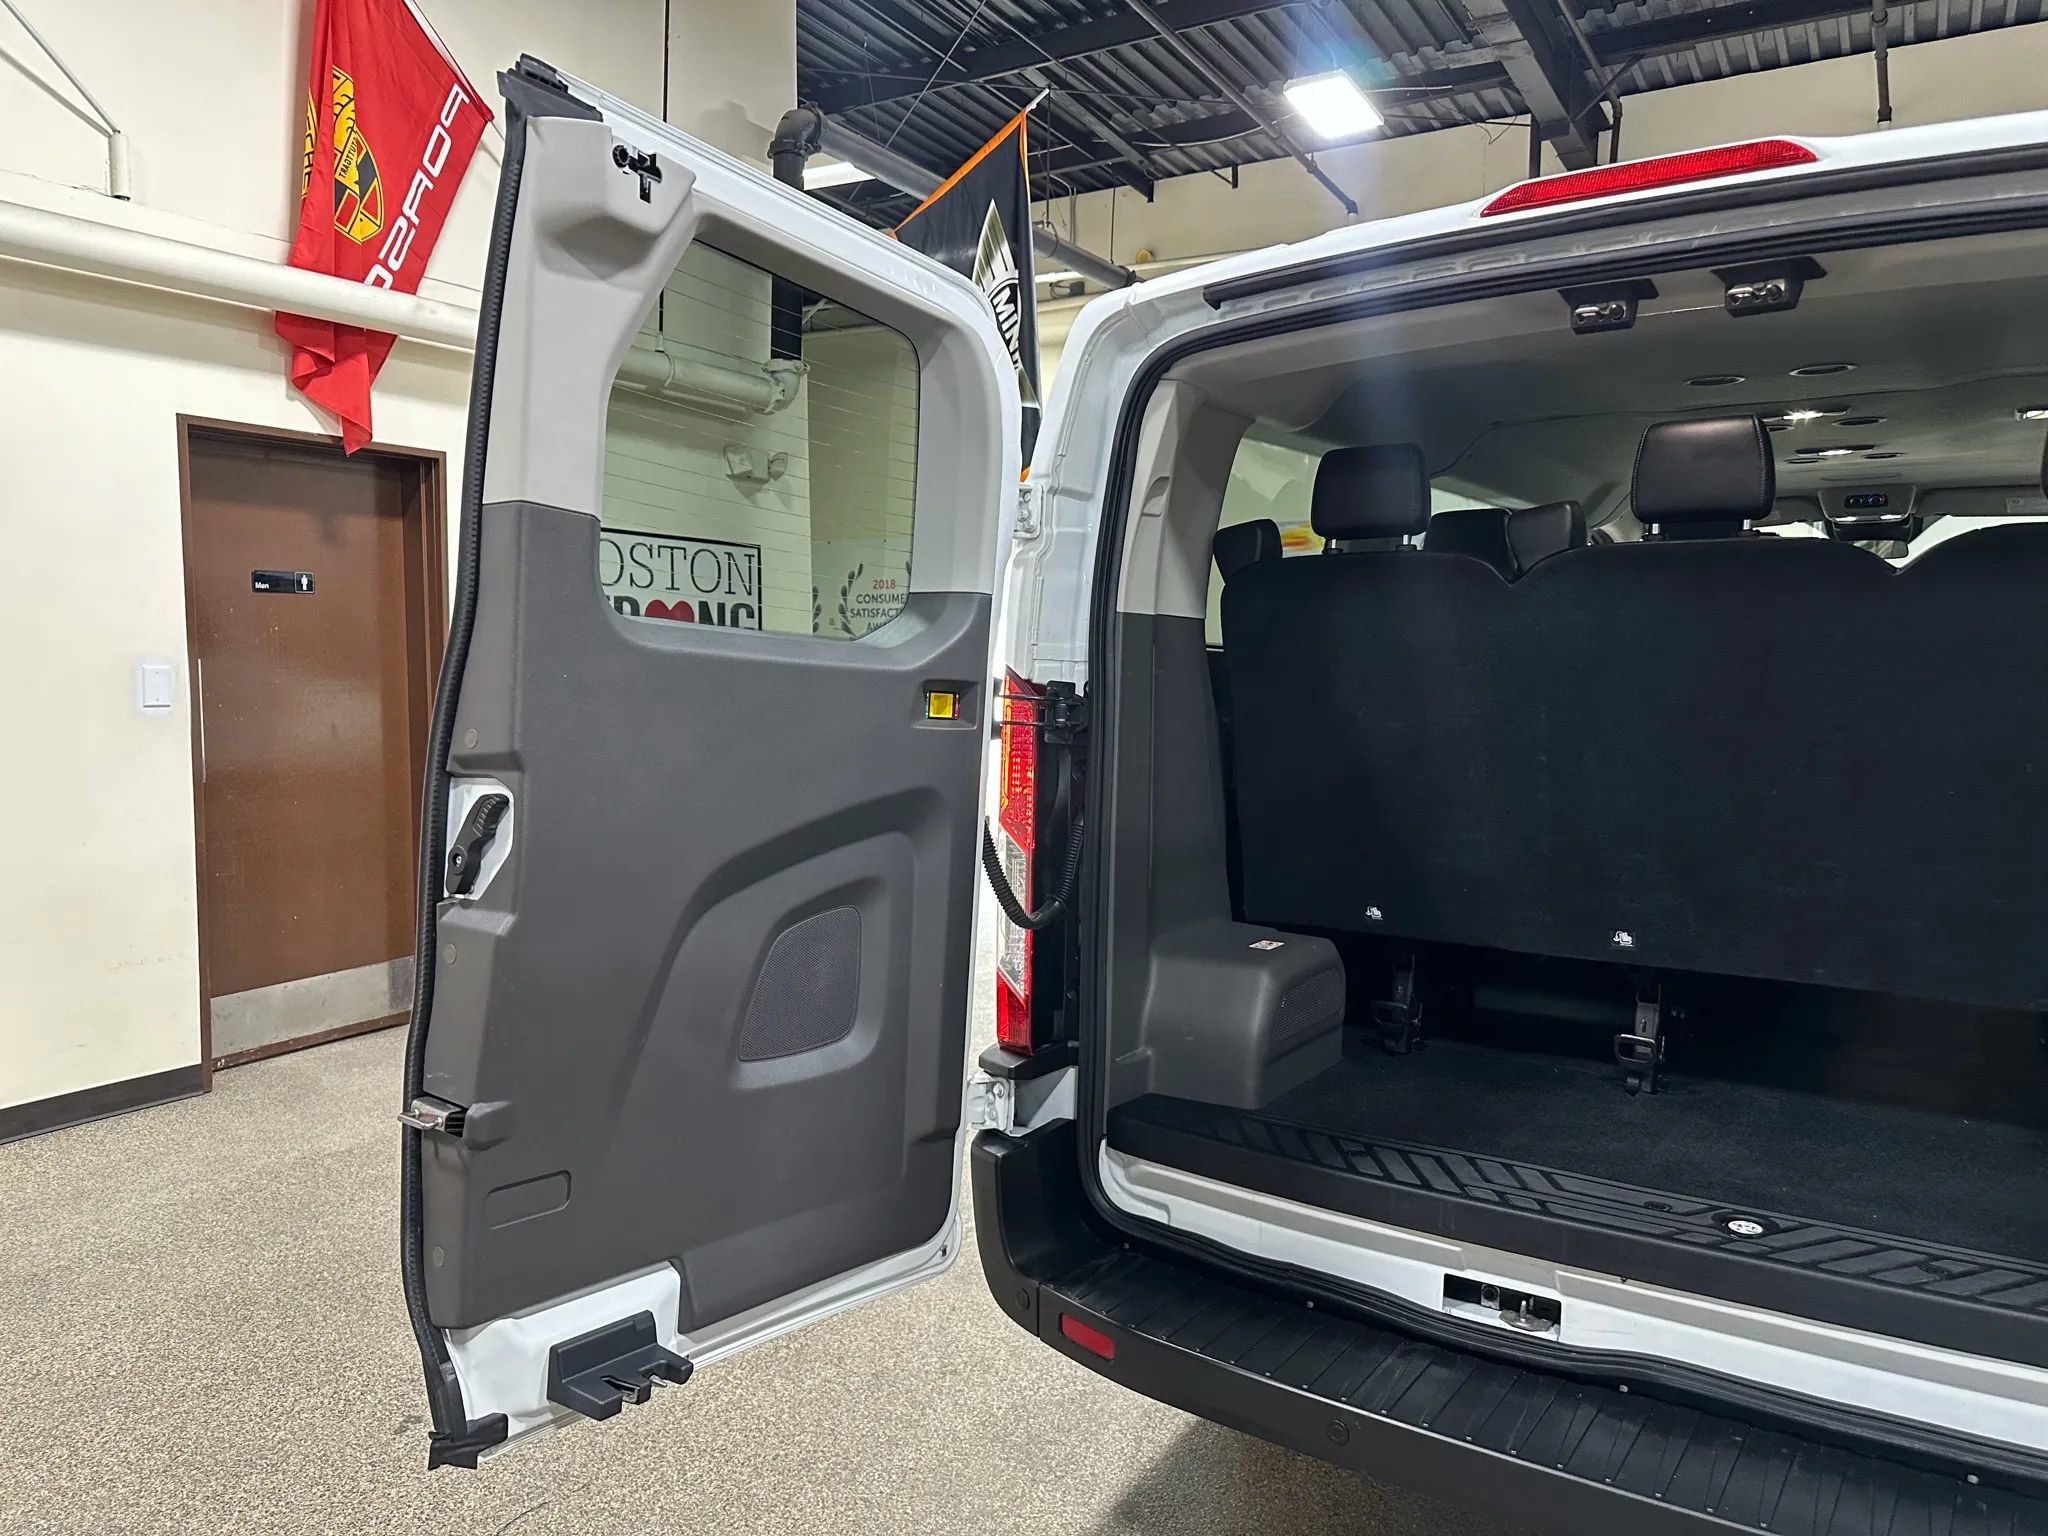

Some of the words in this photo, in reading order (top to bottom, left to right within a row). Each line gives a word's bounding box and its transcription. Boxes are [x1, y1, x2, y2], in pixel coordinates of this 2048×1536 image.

[600, 538, 755, 596] OSTON
[873, 579, 896, 589] 2018
[856, 593, 906, 604] CONSUME
[850, 608, 901, 618] SATISFACT
